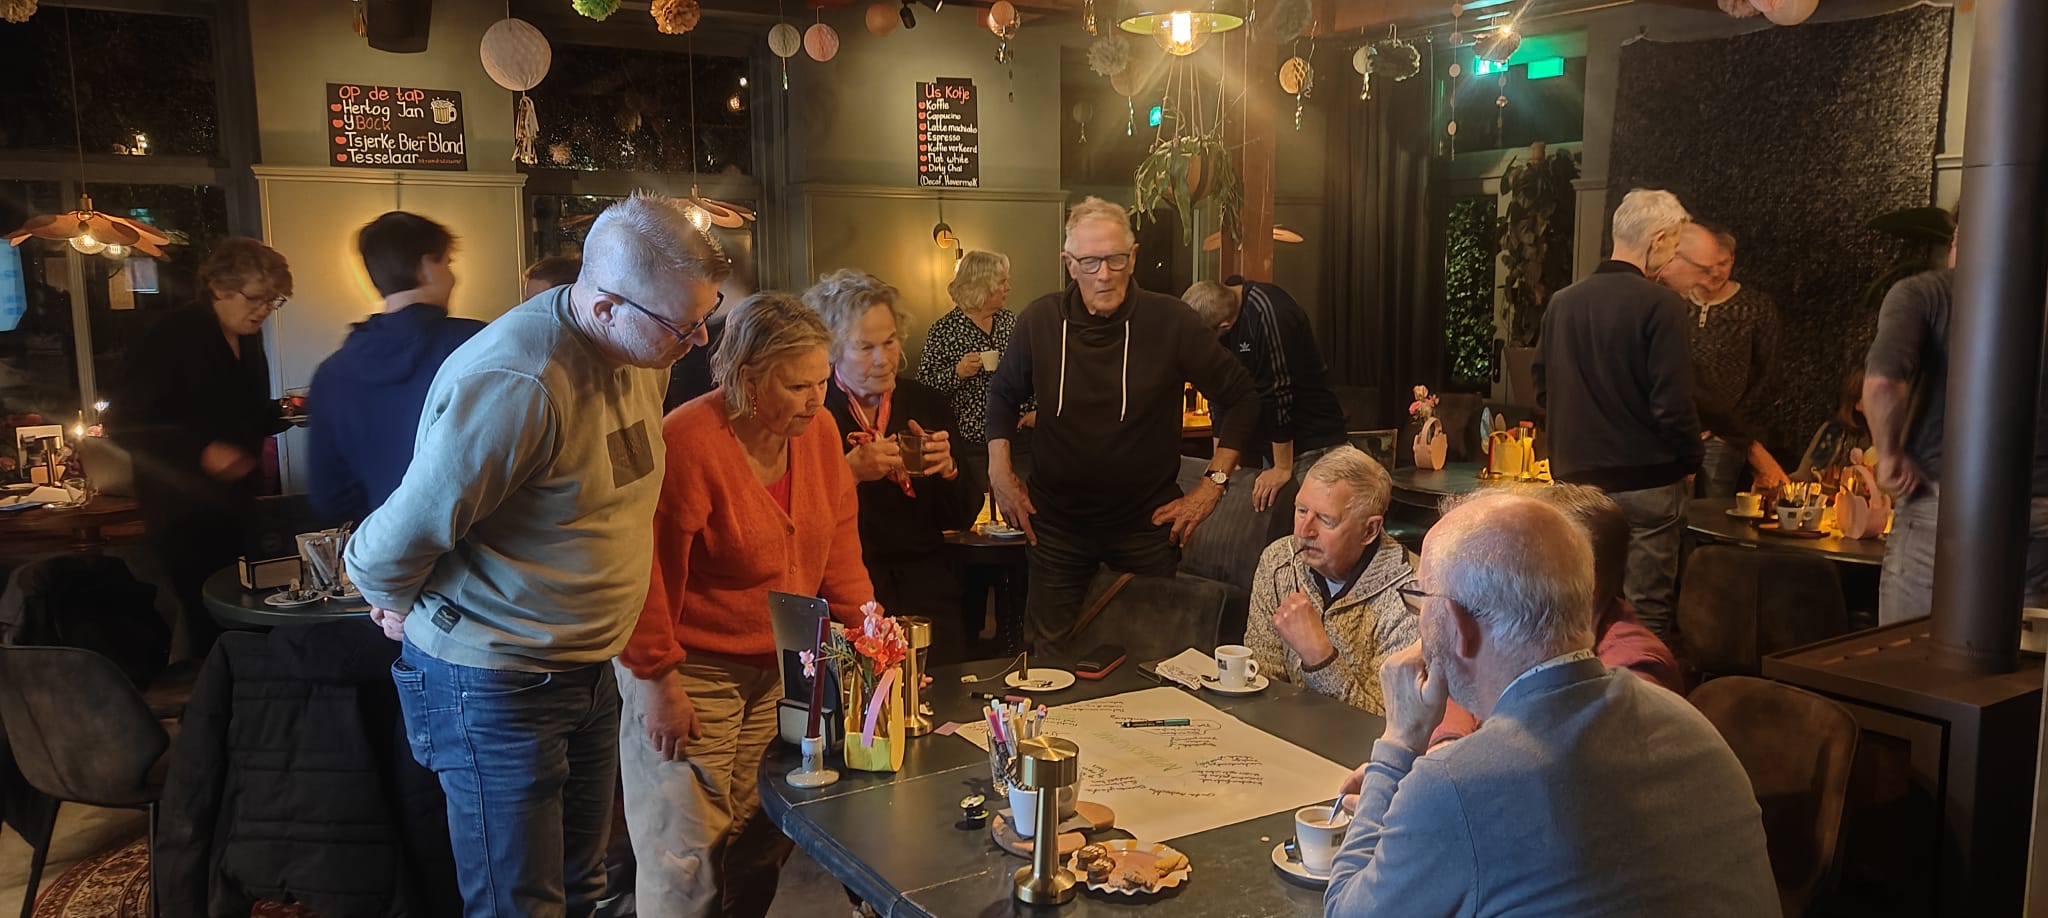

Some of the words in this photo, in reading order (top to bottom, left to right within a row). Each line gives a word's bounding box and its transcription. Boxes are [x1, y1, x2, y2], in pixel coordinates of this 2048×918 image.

[368, 84, 390, 101] de
[395, 86, 425, 105] tap
[342, 98, 390, 122] Hertog
[396, 101, 424, 118] Jan
[925, 98, 950, 110] Koffie
[927, 119, 947, 131] Latte
[398, 132, 427, 153] Bier
[427, 131, 464, 155] Blond
[927, 131, 961, 142] Espresso
[927, 142, 948, 152] Koffie
[346, 148, 419, 164] Tesselaar
[927, 151, 944, 163] Flat
[946, 152, 969, 164] white
[928, 162, 946, 175] Dirty
